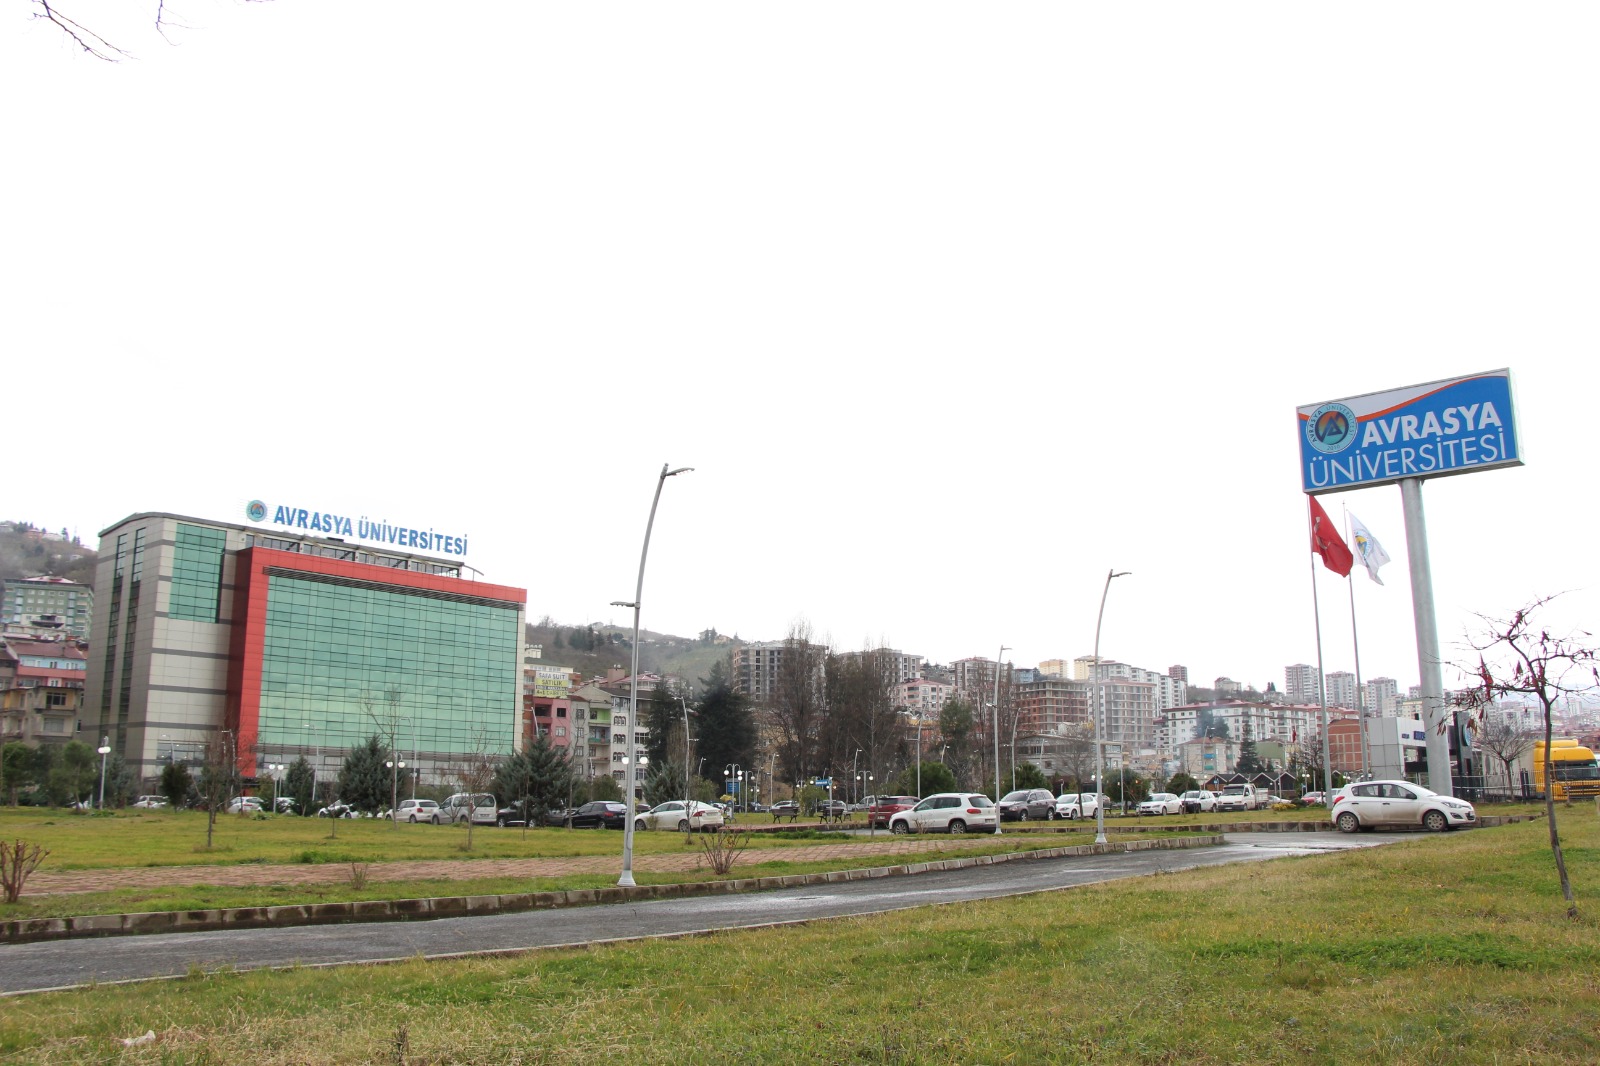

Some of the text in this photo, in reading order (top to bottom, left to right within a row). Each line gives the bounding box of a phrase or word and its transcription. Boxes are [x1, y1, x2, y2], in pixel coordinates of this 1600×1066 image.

[1361, 401, 1502, 448] AVRASYA
[1309, 427, 1506, 487] ÜNİVERSİTESİ
[273, 505, 353, 537] AVRASYA
[358, 515, 468, 556] ÜNİVERSİTESİ
